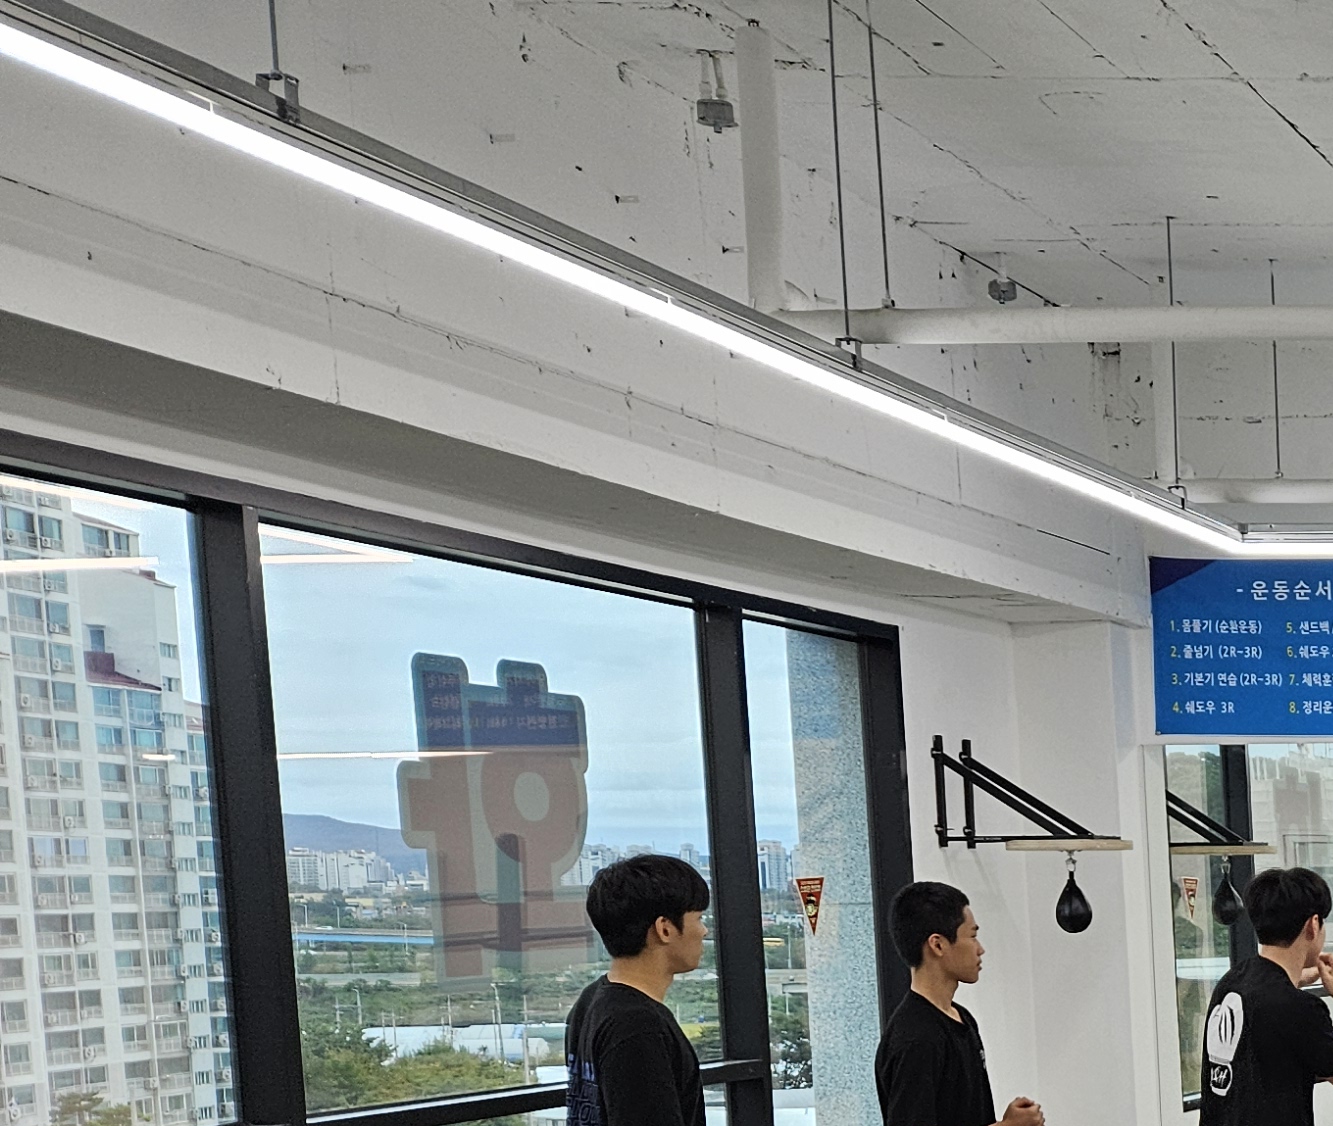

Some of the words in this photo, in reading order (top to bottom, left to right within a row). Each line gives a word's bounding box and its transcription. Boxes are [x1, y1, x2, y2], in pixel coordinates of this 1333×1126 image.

[1251, 580, 1331, 600] 운동순서
[1185, 672, 1214, 686] 기본기
[1218, 673, 1237, 686] 연습
[1221, 702, 1234, 713] 3R
